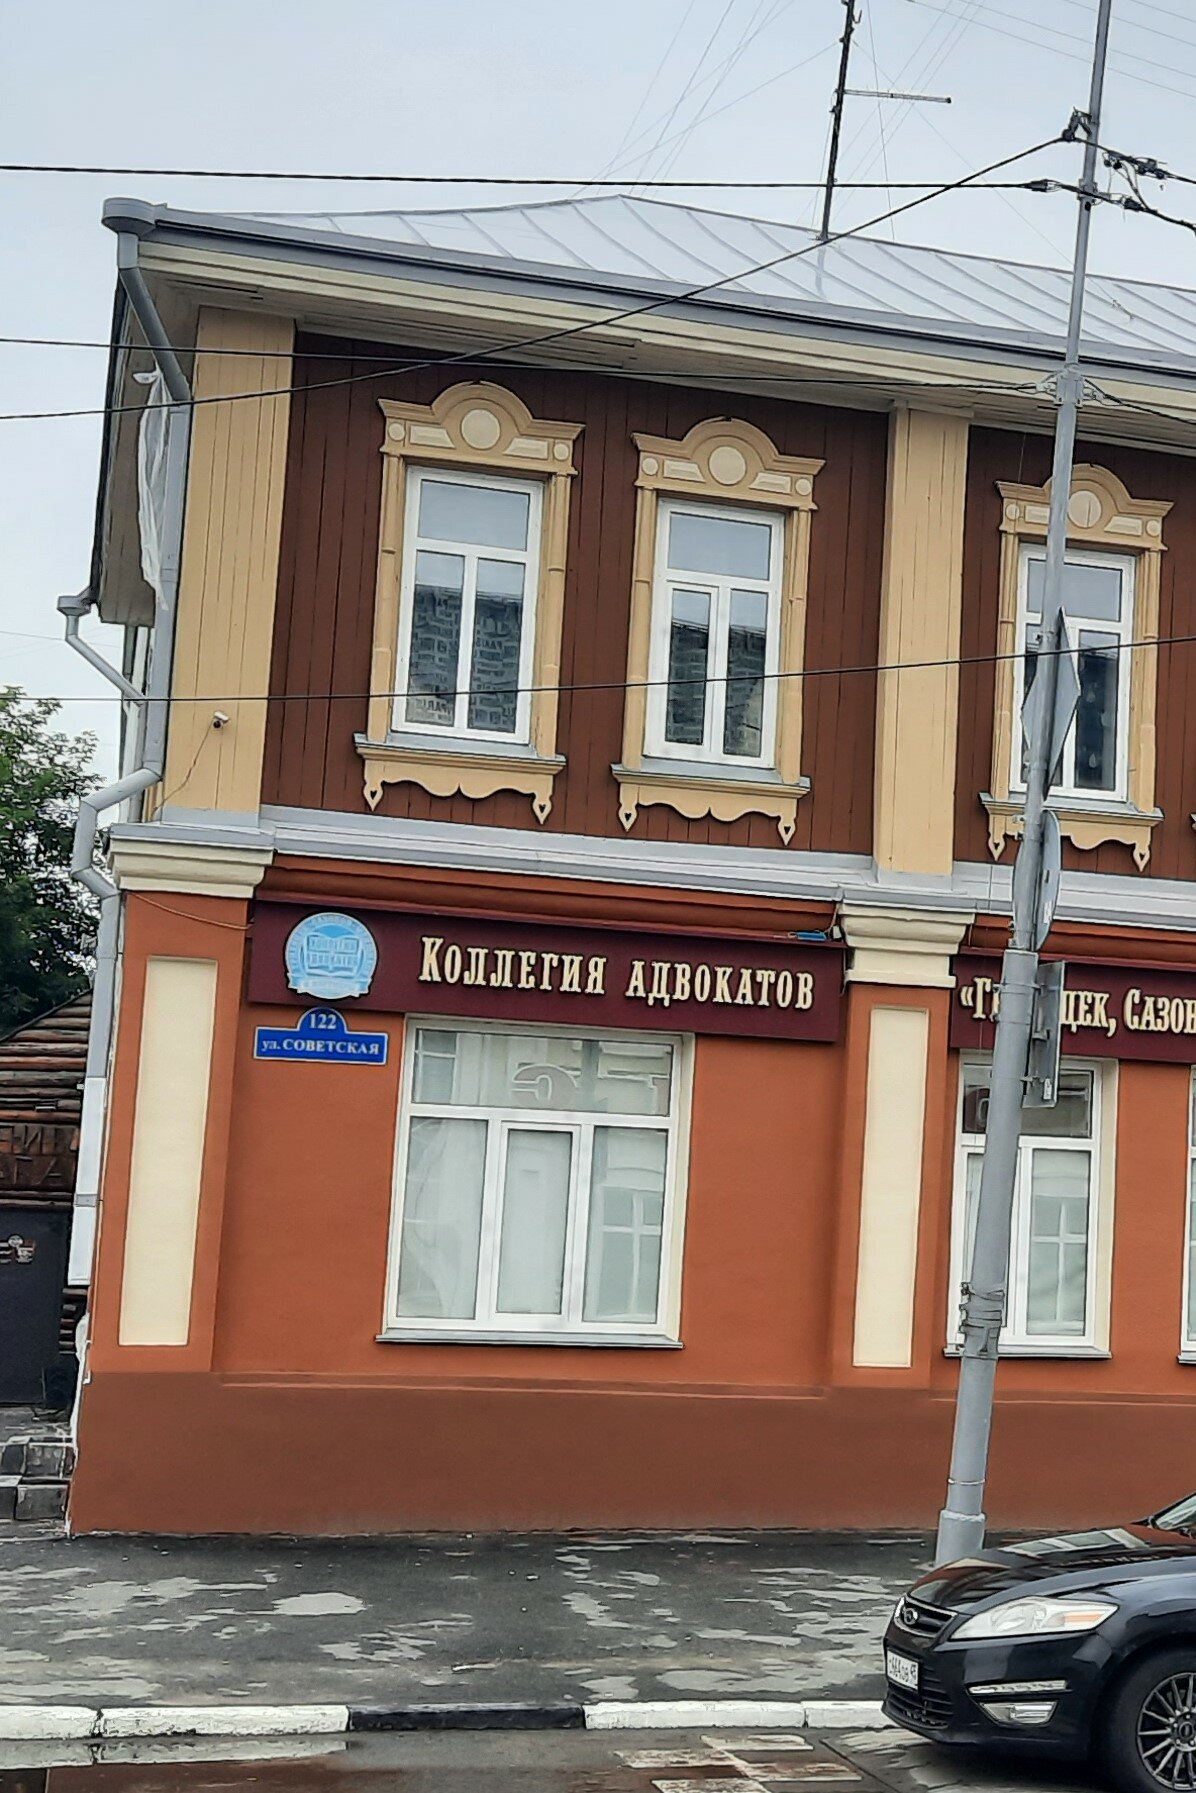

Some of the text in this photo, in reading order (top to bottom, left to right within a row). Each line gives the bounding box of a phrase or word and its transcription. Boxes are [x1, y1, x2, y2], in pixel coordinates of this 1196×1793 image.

[308, 1013, 338, 1031] 122
[260, 1039, 381, 1056] ул. СОВЕТСКАЯ
